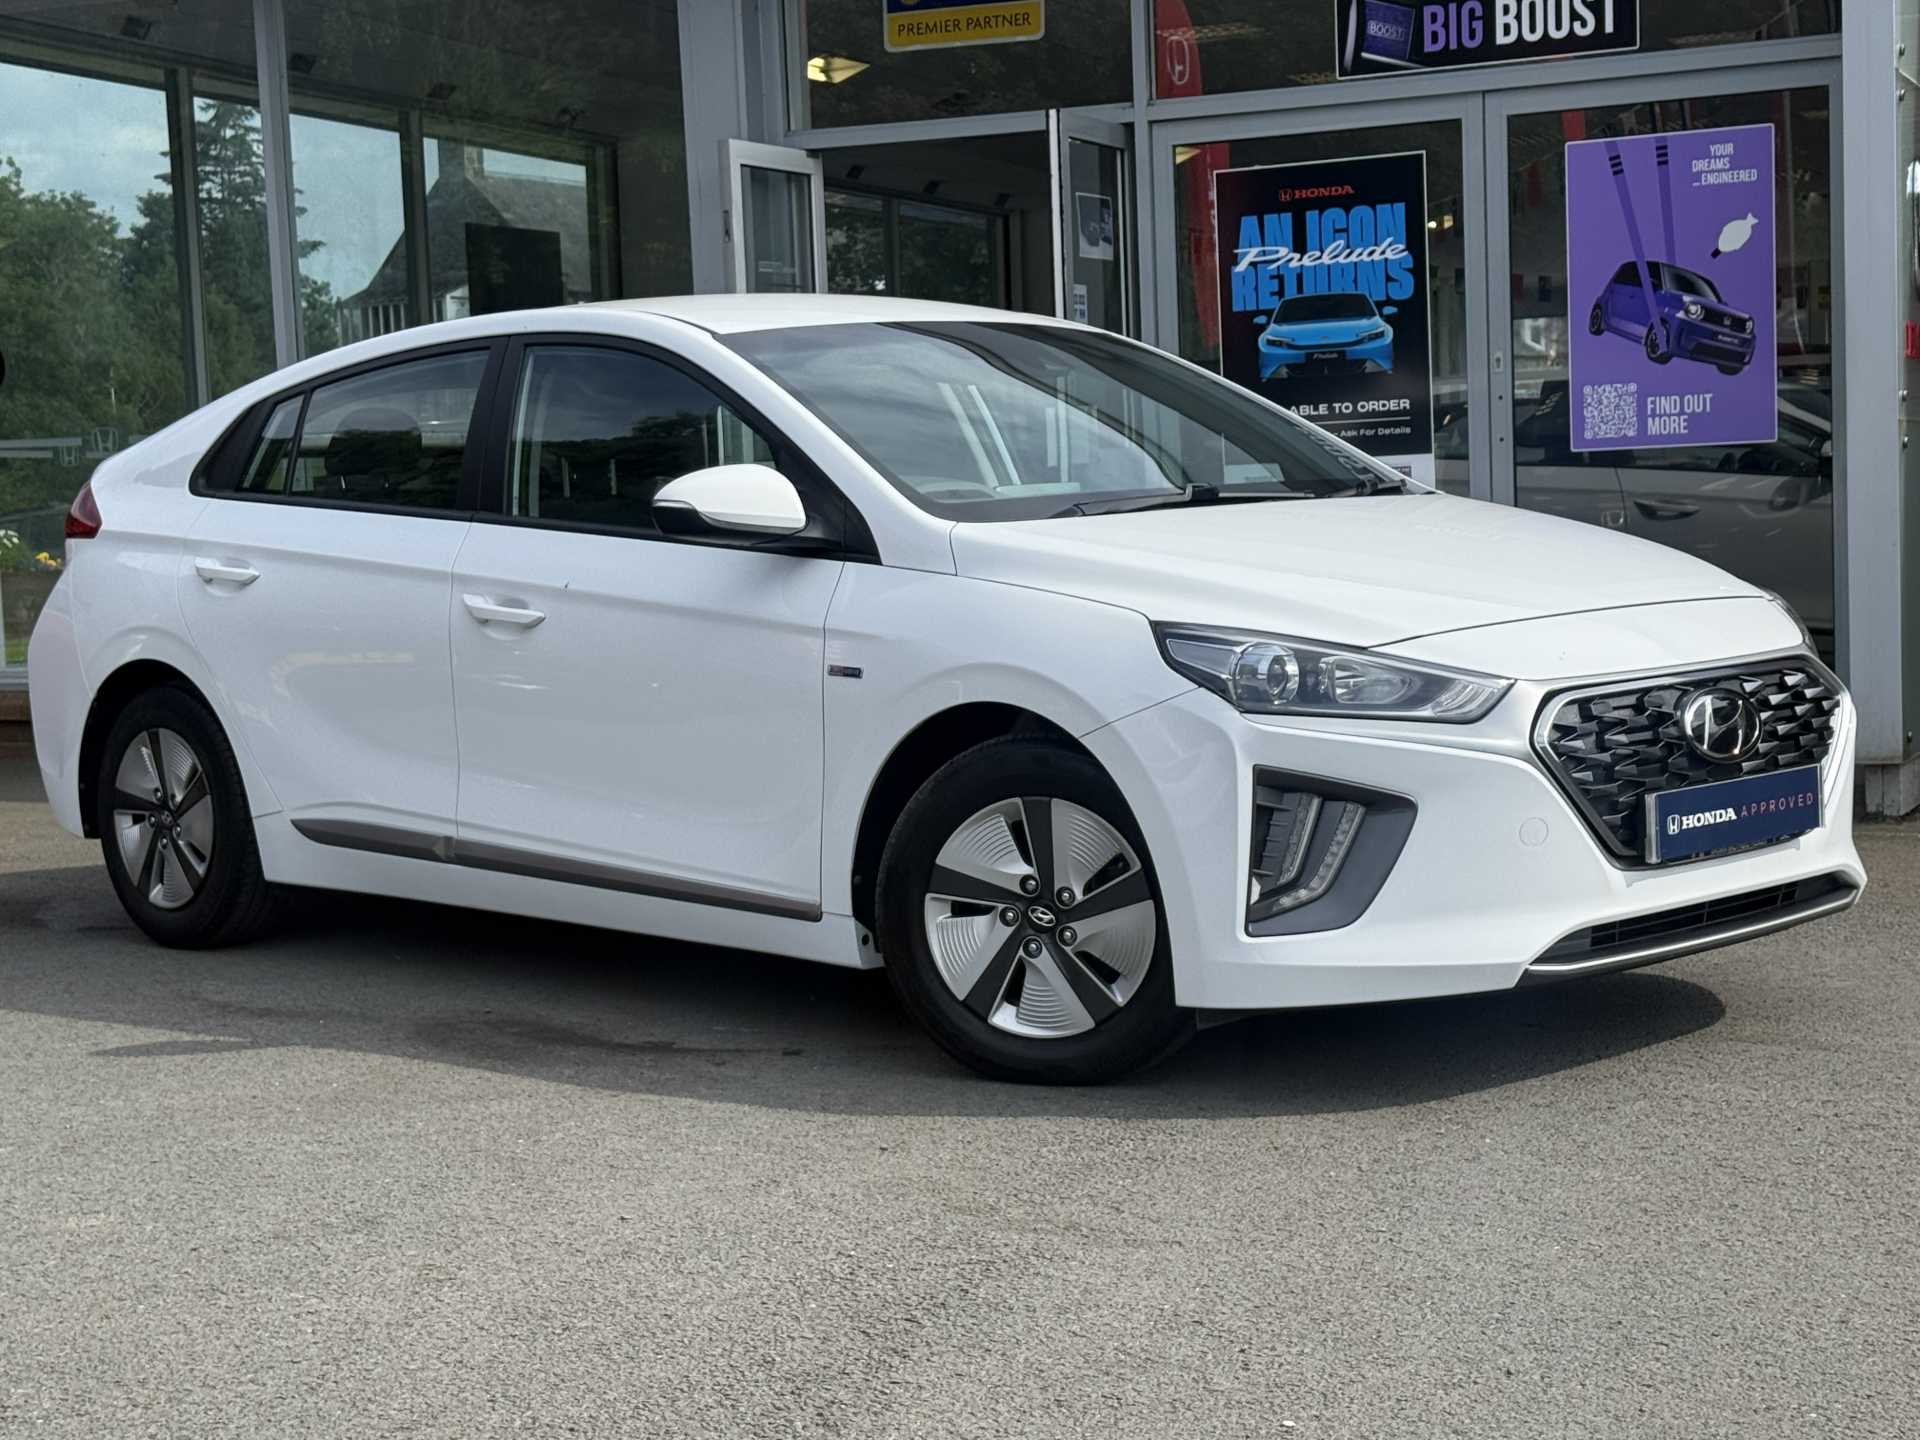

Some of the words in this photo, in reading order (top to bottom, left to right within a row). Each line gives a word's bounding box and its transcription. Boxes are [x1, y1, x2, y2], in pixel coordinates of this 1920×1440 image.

[897, 19, 962, 37] PREMIER
[966, 12, 1032, 31] PARTNER
[1369, 21, 1405, 40] BOOST
[1423, 1, 1483, 53] BIG
[1495, 0, 1614, 45] BOOST
[1709, 143, 1734, 156] YOUR
[1692, 157, 1730, 172] DREAMS
[1294, 185, 1355, 200] HONDA
[1237, 212, 1294, 265] AN
[1305, 202, 1407, 258] ICON
[1233, 236, 1409, 272] Prelude
[1231, 252, 1415, 312] RETURNS
[1332, 402, 1353, 414] TO
[1357, 399, 1410, 413] ORDER
[1647, 396, 1681, 415] FIND
[1684, 393, 1713, 413] OUT
[1360, 428, 1376, 437] For
[1377, 426, 1411, 435] Details
[1647, 415, 1689, 435] MORE
[1681, 807, 1738, 830] HONDA
[1740, 792, 1814, 818] APPROVED
